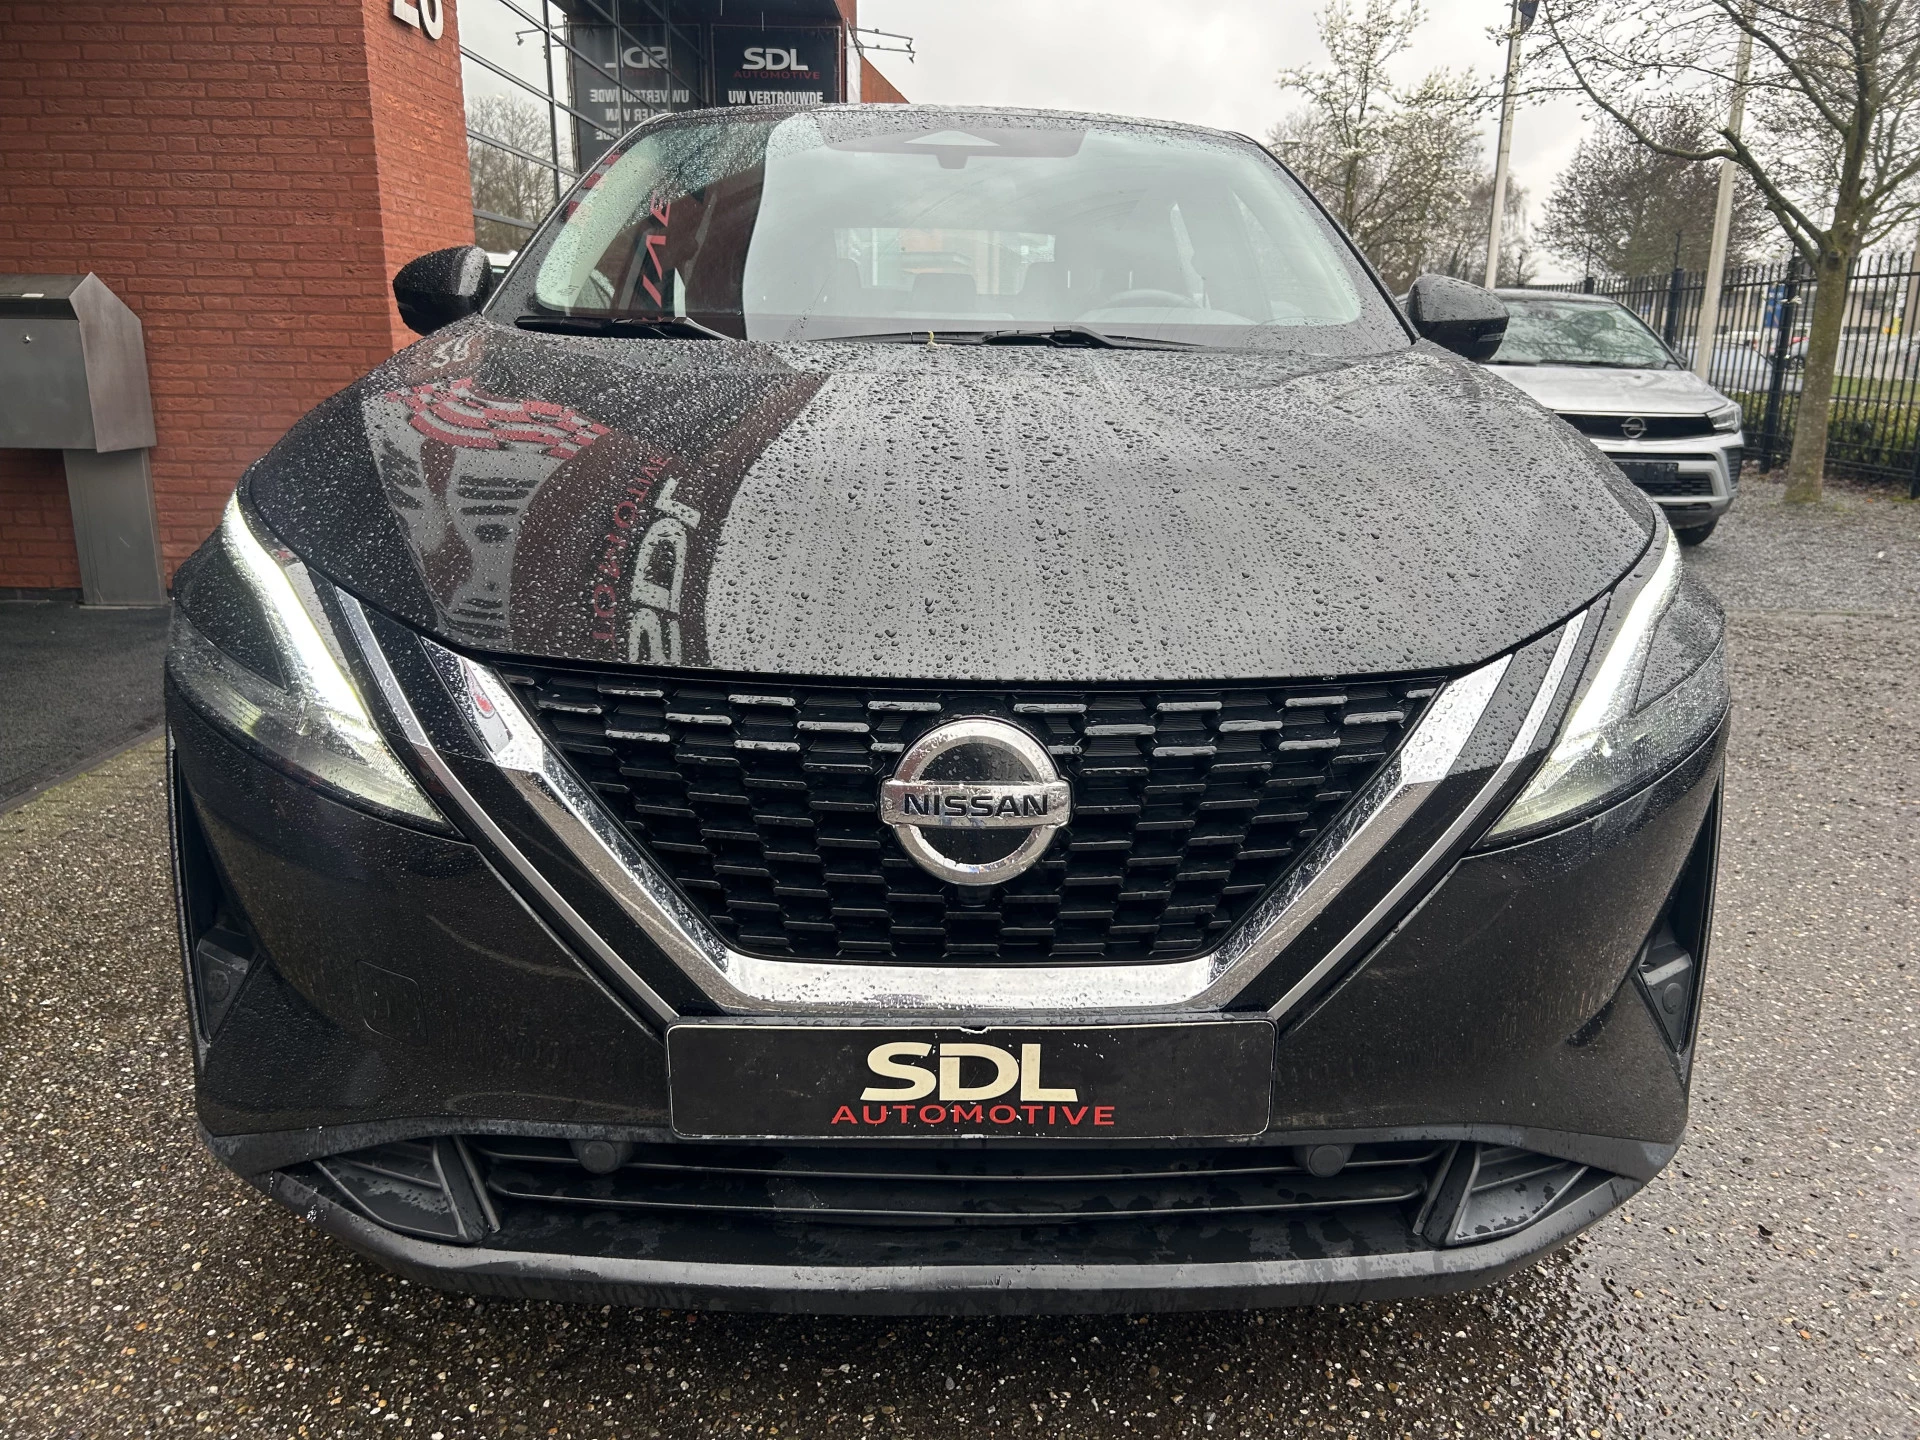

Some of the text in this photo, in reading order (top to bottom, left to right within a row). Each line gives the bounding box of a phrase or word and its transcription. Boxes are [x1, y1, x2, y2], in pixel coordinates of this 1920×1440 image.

[742, 47, 809, 71] SDL
[733, 71, 821, 80] AUTOMOTIVE
[728, 90, 824, 105] UW VERTROUWDE
[904, 793, 1049, 817] NISSAN
[859, 1041, 1079, 1102] SDL
[830, 1104, 1116, 1126] AUTOMOTIVE
